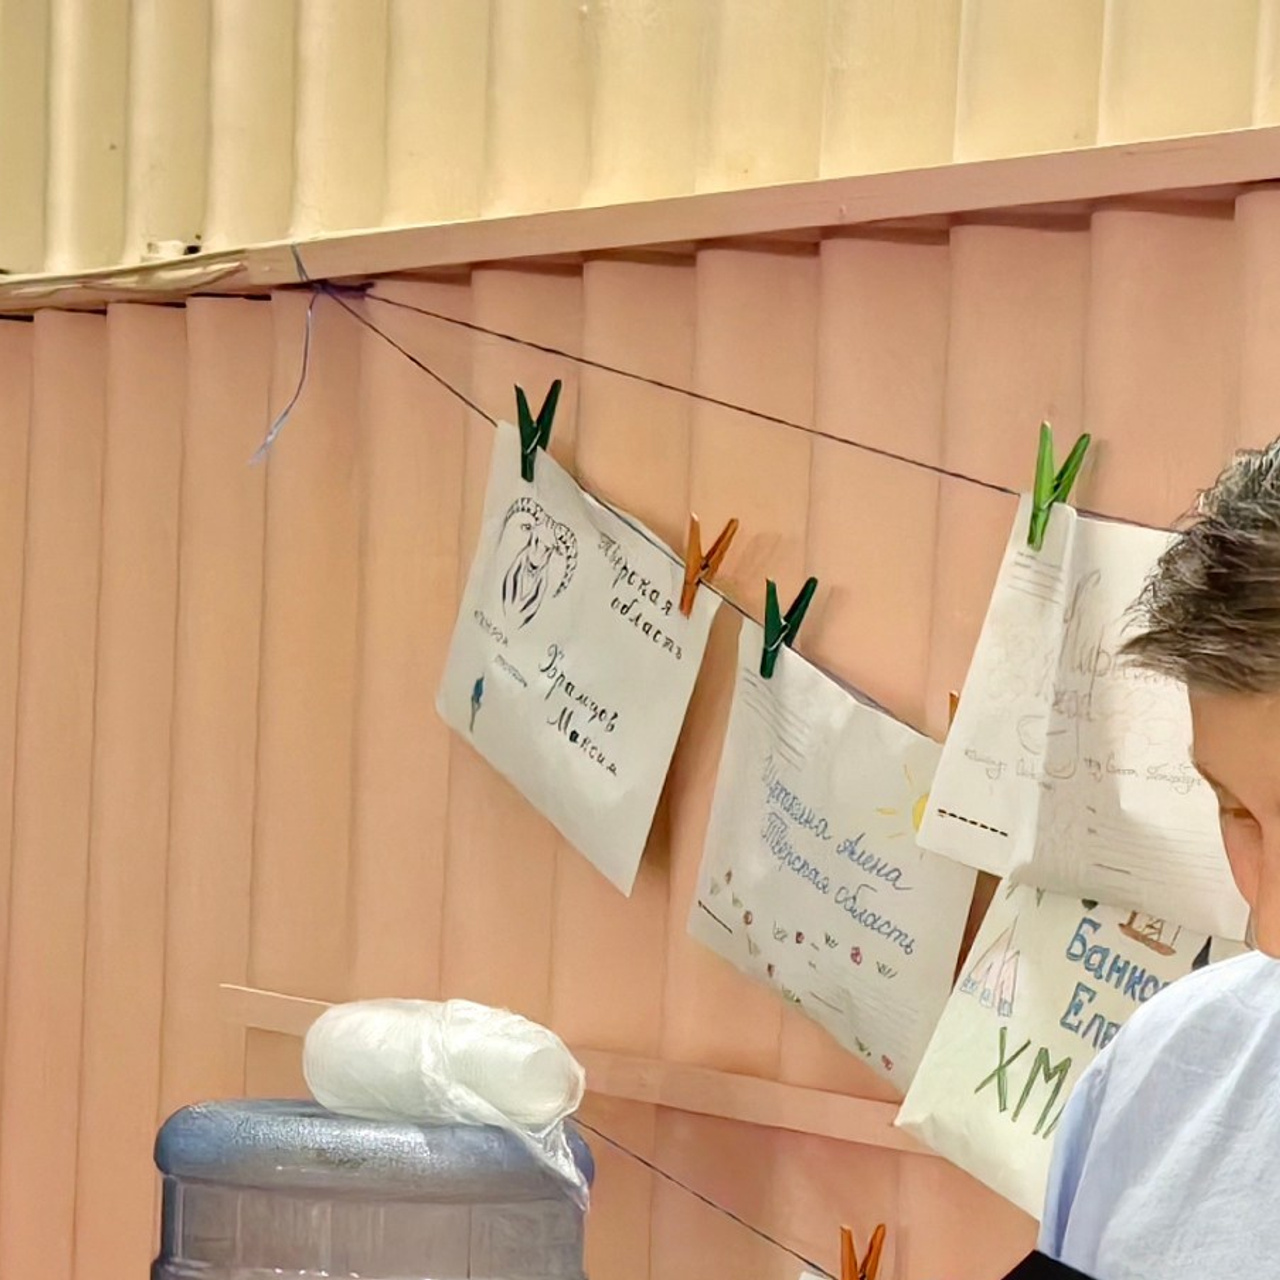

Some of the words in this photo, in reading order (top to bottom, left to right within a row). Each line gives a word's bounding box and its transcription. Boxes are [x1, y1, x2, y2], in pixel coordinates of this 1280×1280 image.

[610, 597, 683, 661] область
[834, 884, 915, 956] область
[1066, 917, 1172, 1005] Банко
[1060, 982, 1121, 1050] Еле
[974, 1026, 1072, 1139] ХМ
